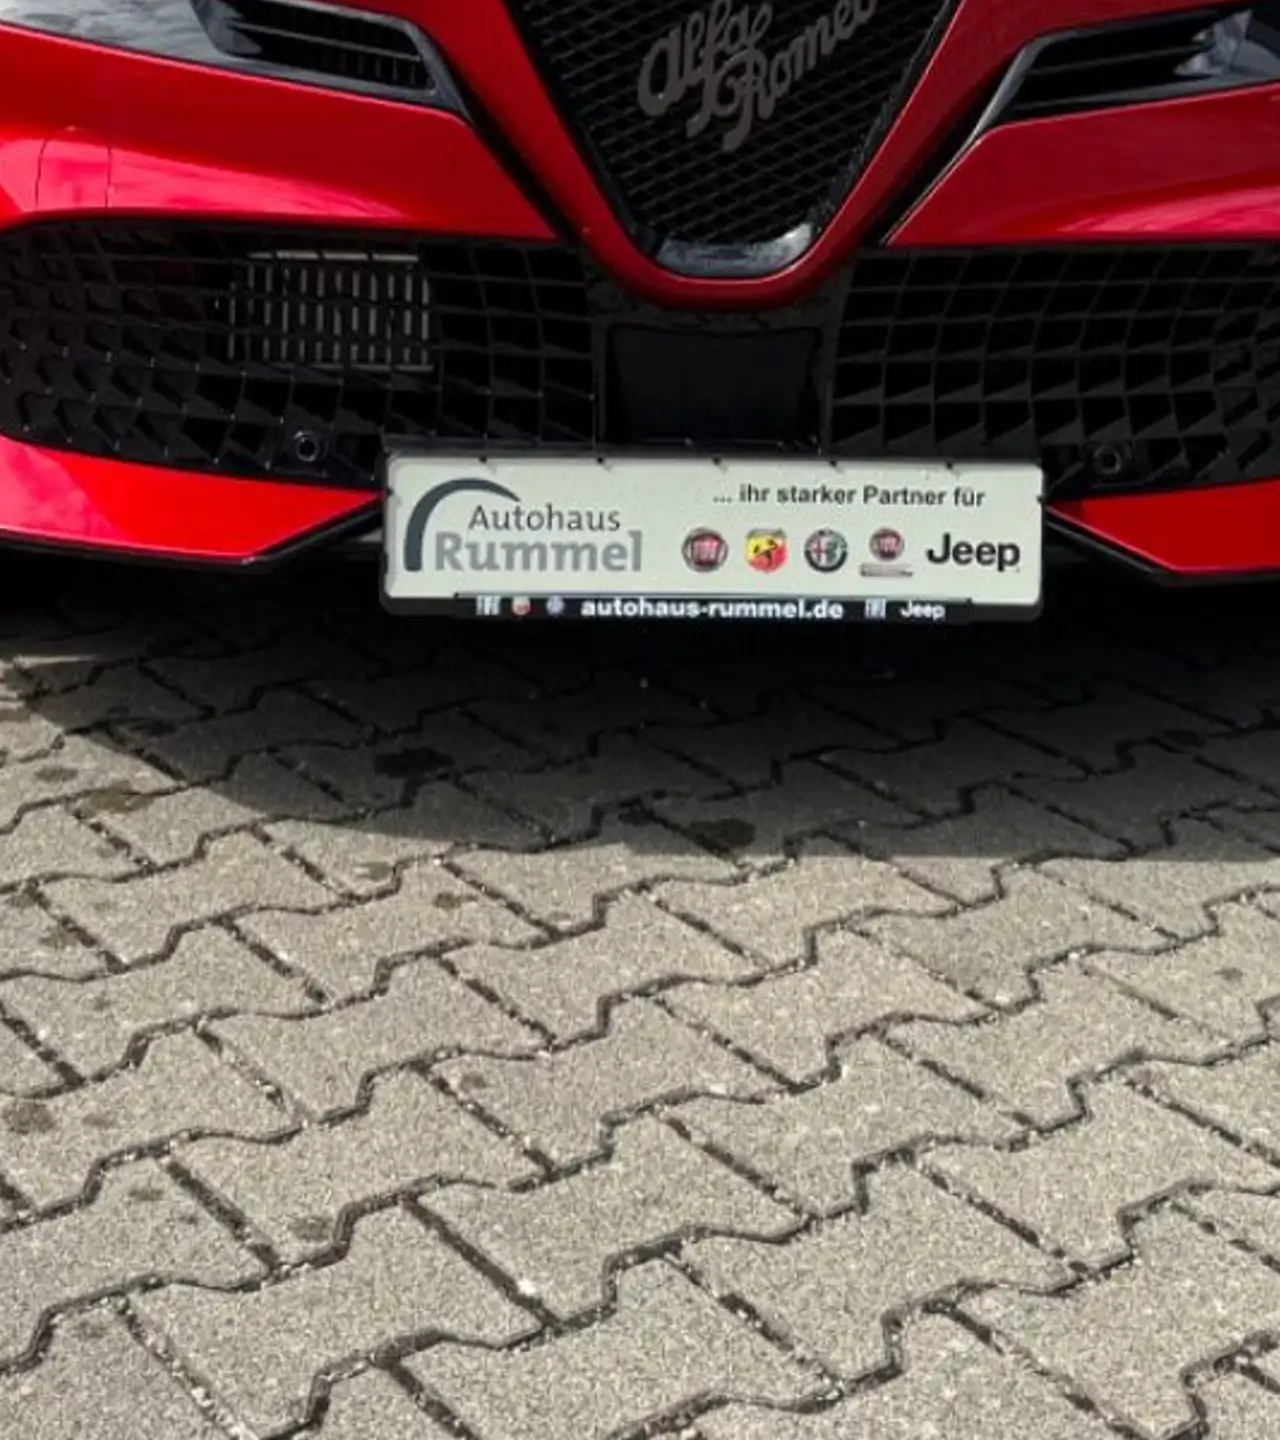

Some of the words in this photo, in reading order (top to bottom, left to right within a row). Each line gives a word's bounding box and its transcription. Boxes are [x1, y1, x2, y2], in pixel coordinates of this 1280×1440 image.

[776, 485, 858, 506] starker
[862, 484, 948, 507] Partner
[953, 486, 986, 508] für
[468, 502, 621, 532] Autohaus
[434, 529, 644, 573] Rummel
[925, 532, 1021, 572] Jeep
[580, 596, 845, 621] autohaus-rummel.de
